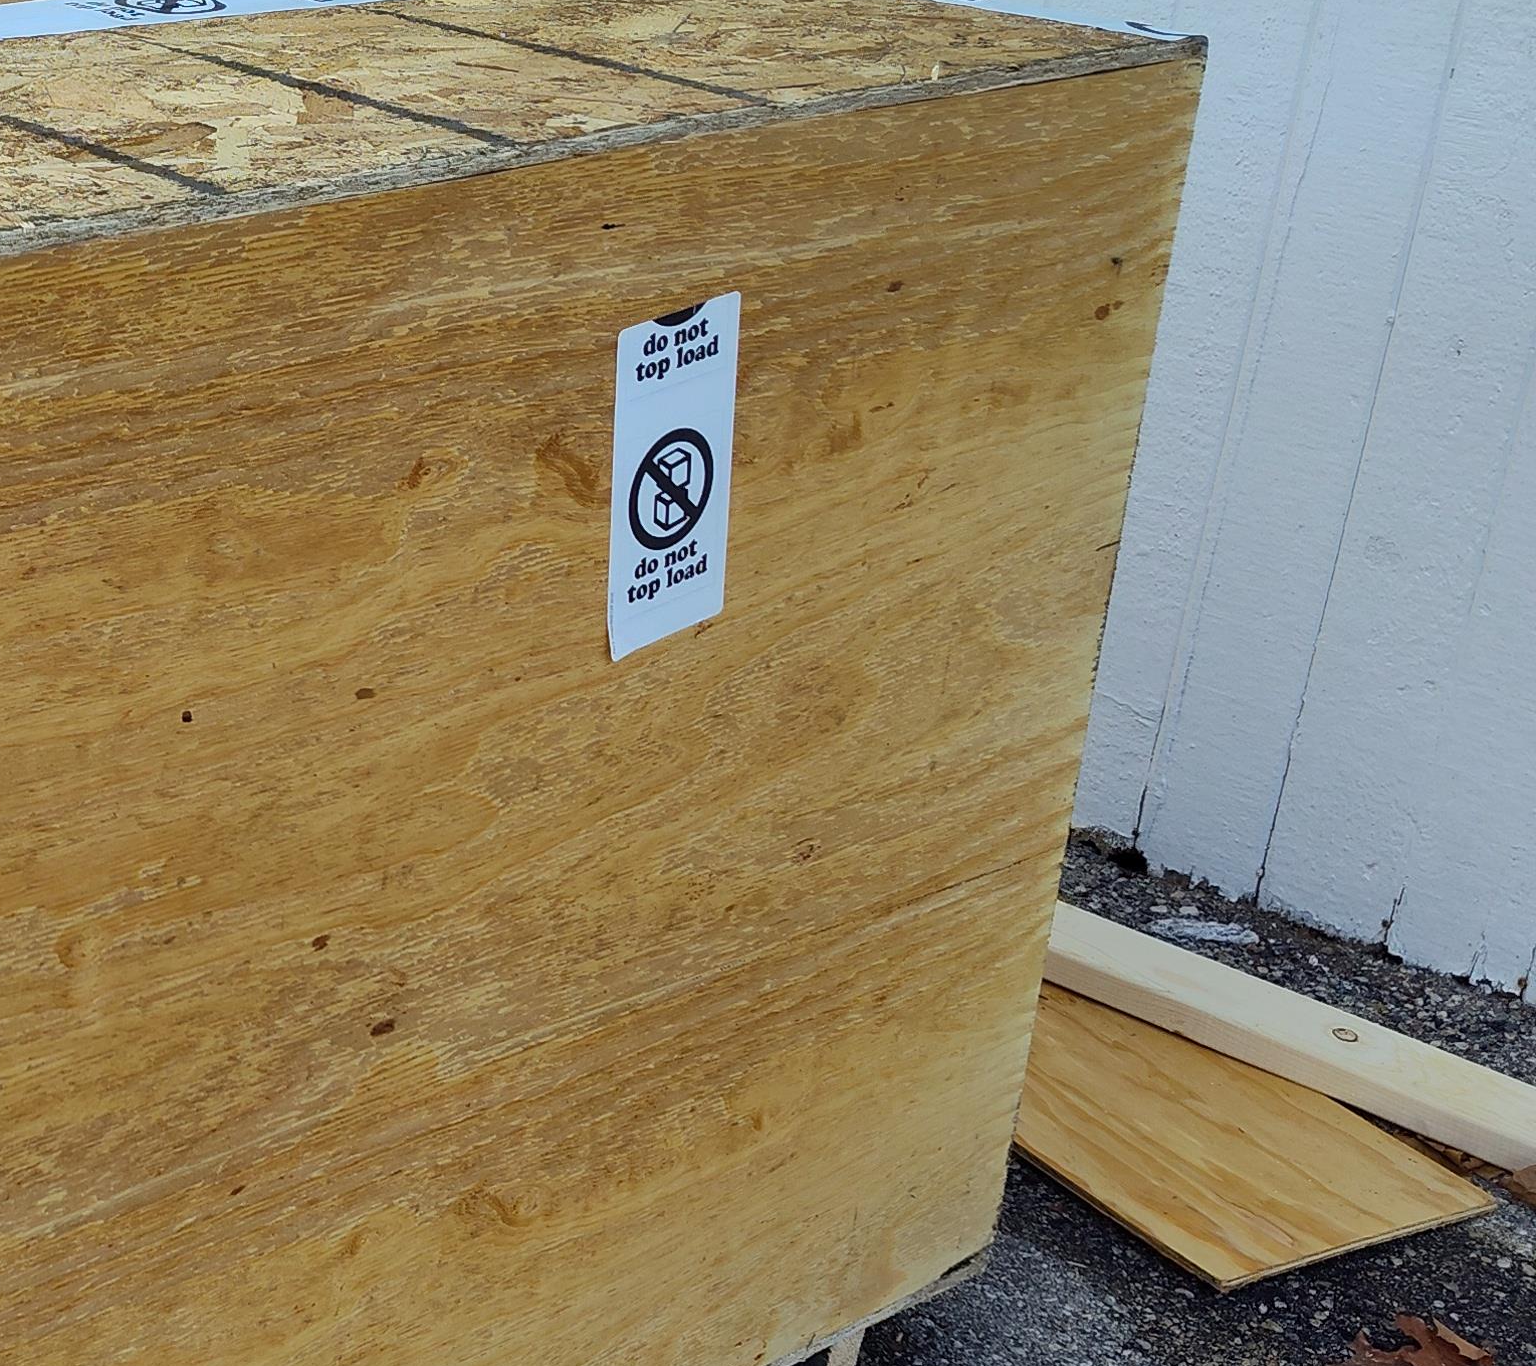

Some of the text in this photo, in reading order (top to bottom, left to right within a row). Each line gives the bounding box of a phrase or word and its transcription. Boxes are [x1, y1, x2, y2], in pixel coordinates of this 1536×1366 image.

[635, 335, 719, 382] top load
[643, 317, 709, 357] do not
[627, 554, 708, 603] top load
[634, 539, 698, 580] do not
